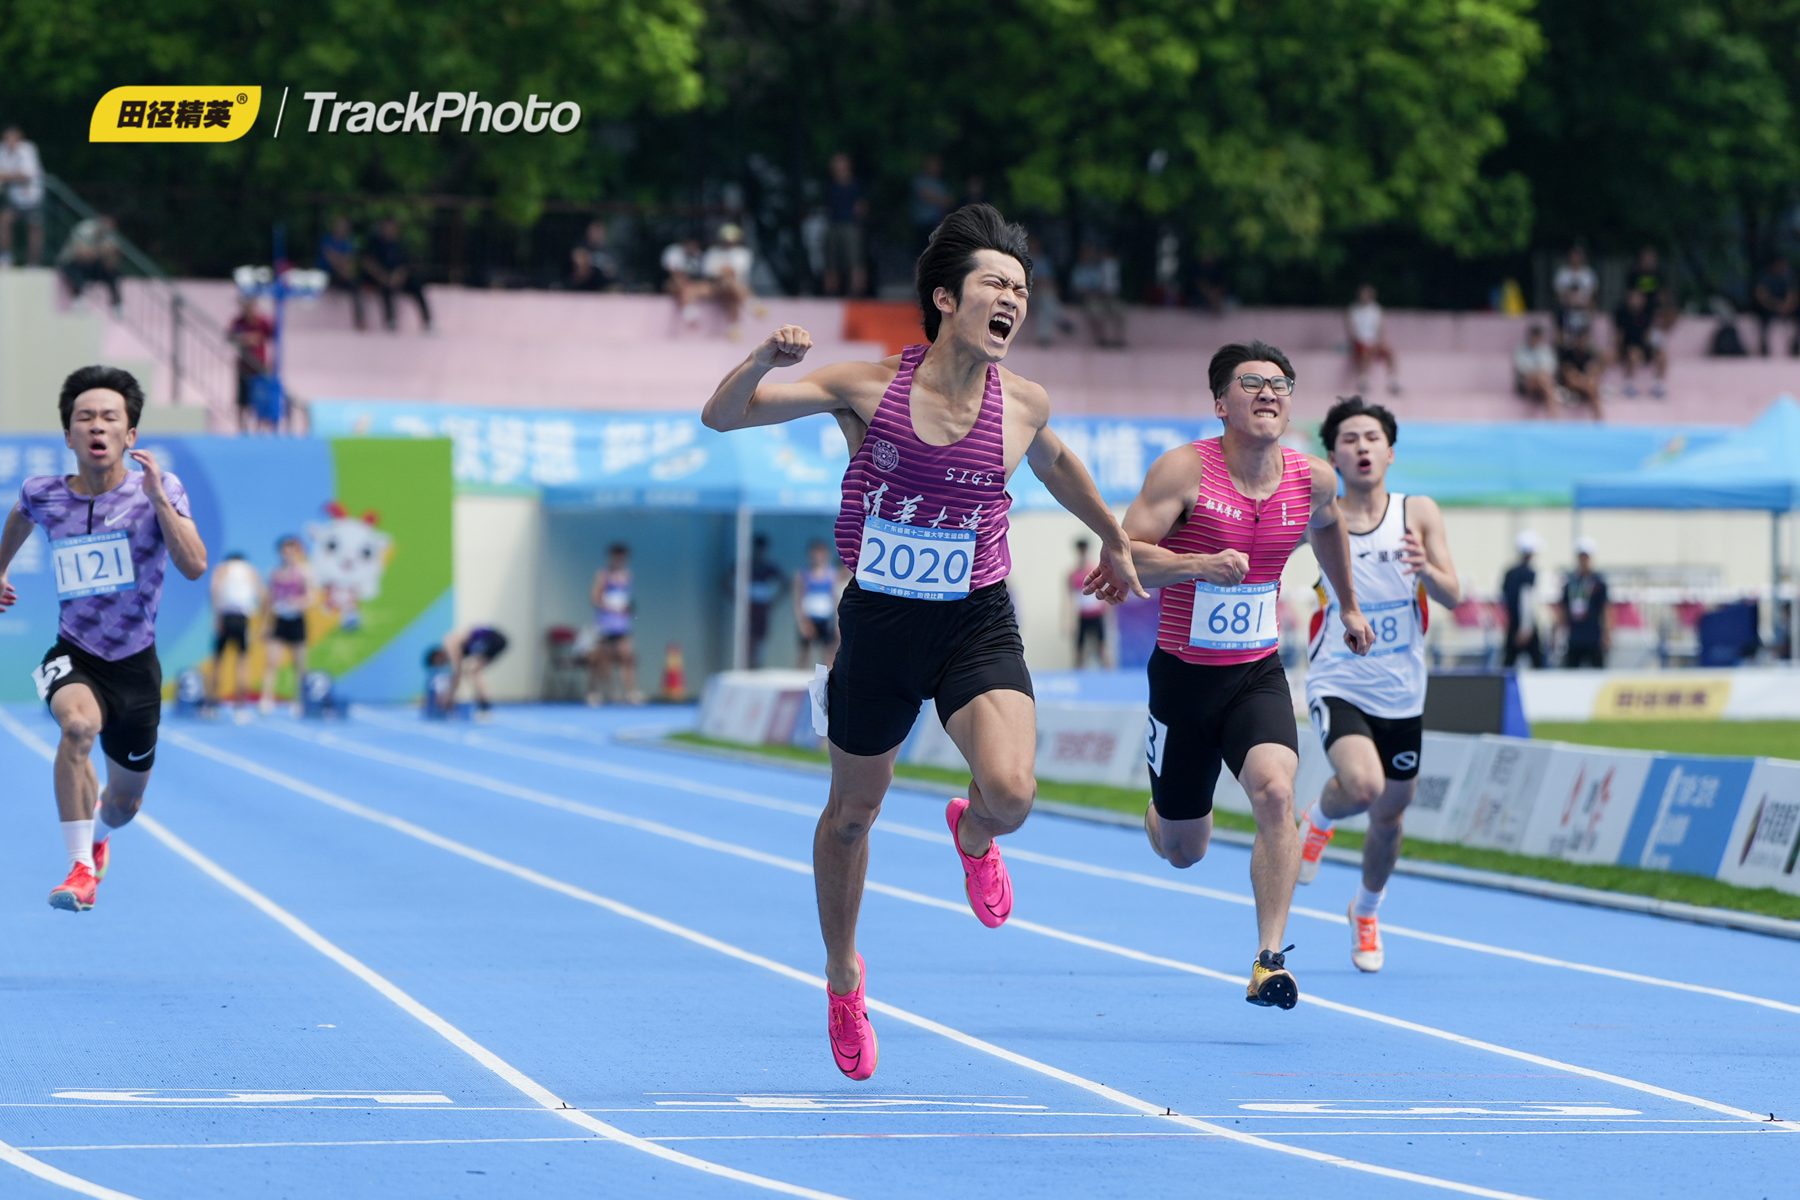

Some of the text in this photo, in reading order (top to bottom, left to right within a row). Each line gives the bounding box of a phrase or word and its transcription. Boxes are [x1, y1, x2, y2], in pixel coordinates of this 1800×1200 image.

[945, 467, 995, 487] SIGS
[58, 547, 123, 585] 1121
[863, 537, 969, 585] 2020
[1207, 601, 1264, 635] 681
